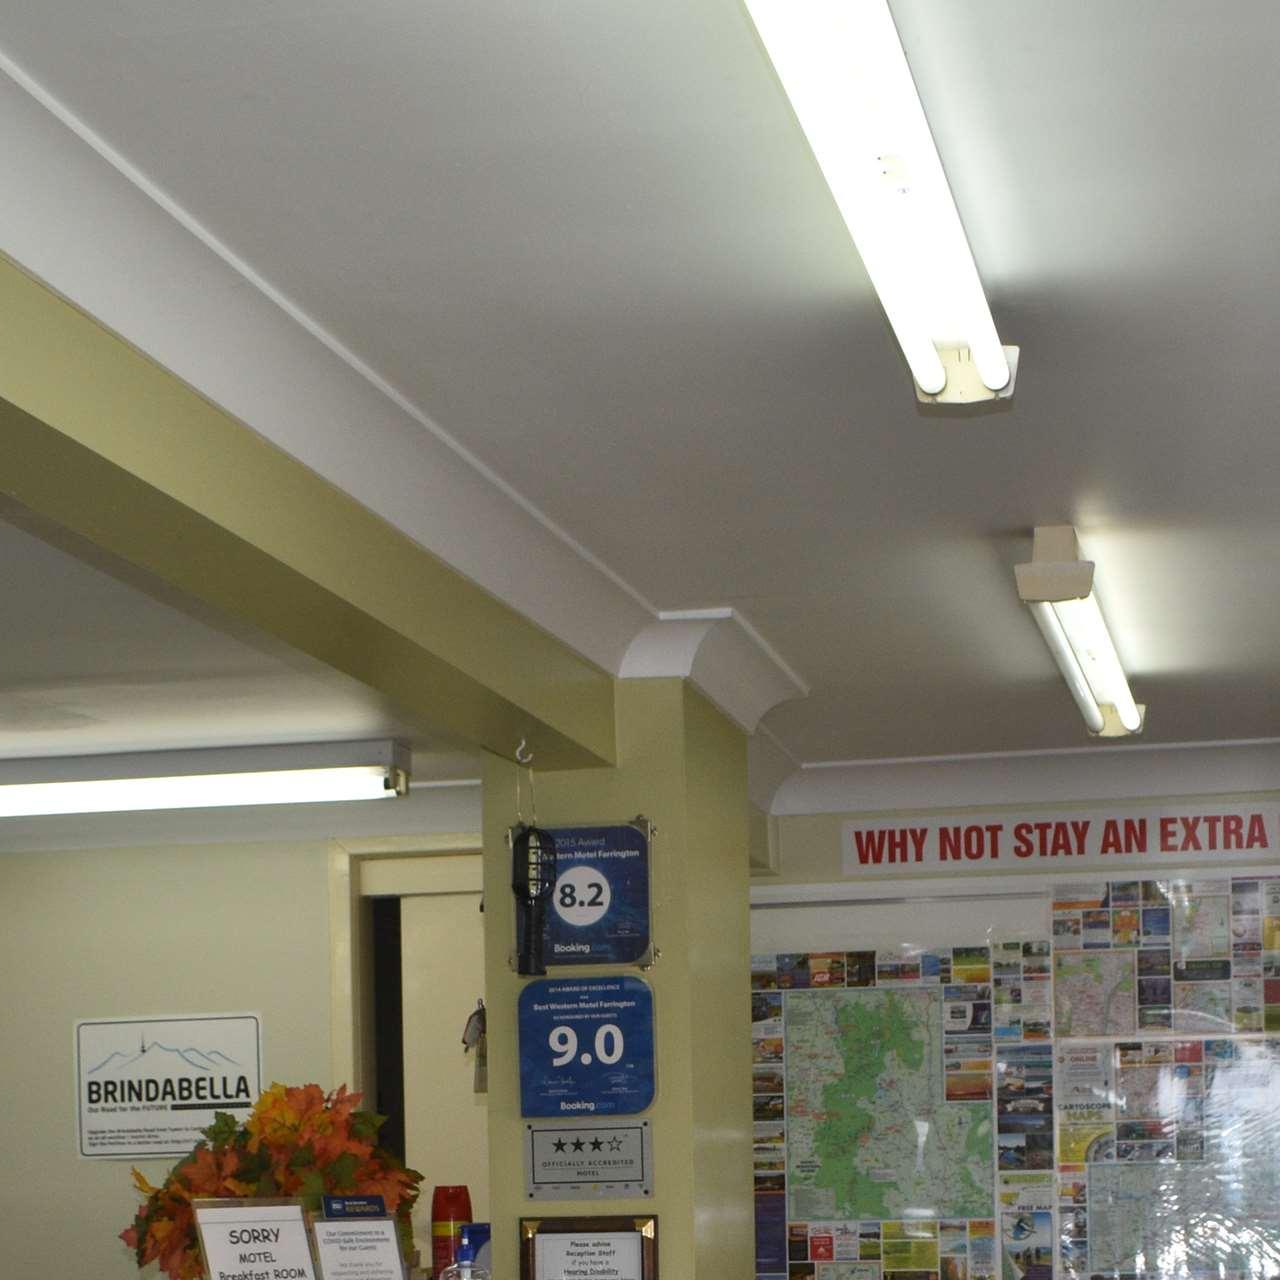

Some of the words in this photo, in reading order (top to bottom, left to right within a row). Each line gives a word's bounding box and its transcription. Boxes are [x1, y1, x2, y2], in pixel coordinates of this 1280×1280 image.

[578, 838, 605, 846] Award
[854, 828, 928, 865] WHY
[938, 825, 1003, 862] NOT
[1013, 821, 1090, 858] STAY
[1100, 818, 1147, 854] AN
[1160, 814, 1269, 852] EXTRA
[559, 883, 604, 908] 8.2
[550, 1002, 577, 1010] Western
[600, 1000, 636, 1008] Farrington
[548, 1024, 624, 1067] 9.0
[88, 1076, 250, 1104] BRINDABELLA
[229, 1228, 280, 1244] SORRY
[239, 1252, 276, 1264] MOTEL
[273, 1268, 307, 1280] ROOM
